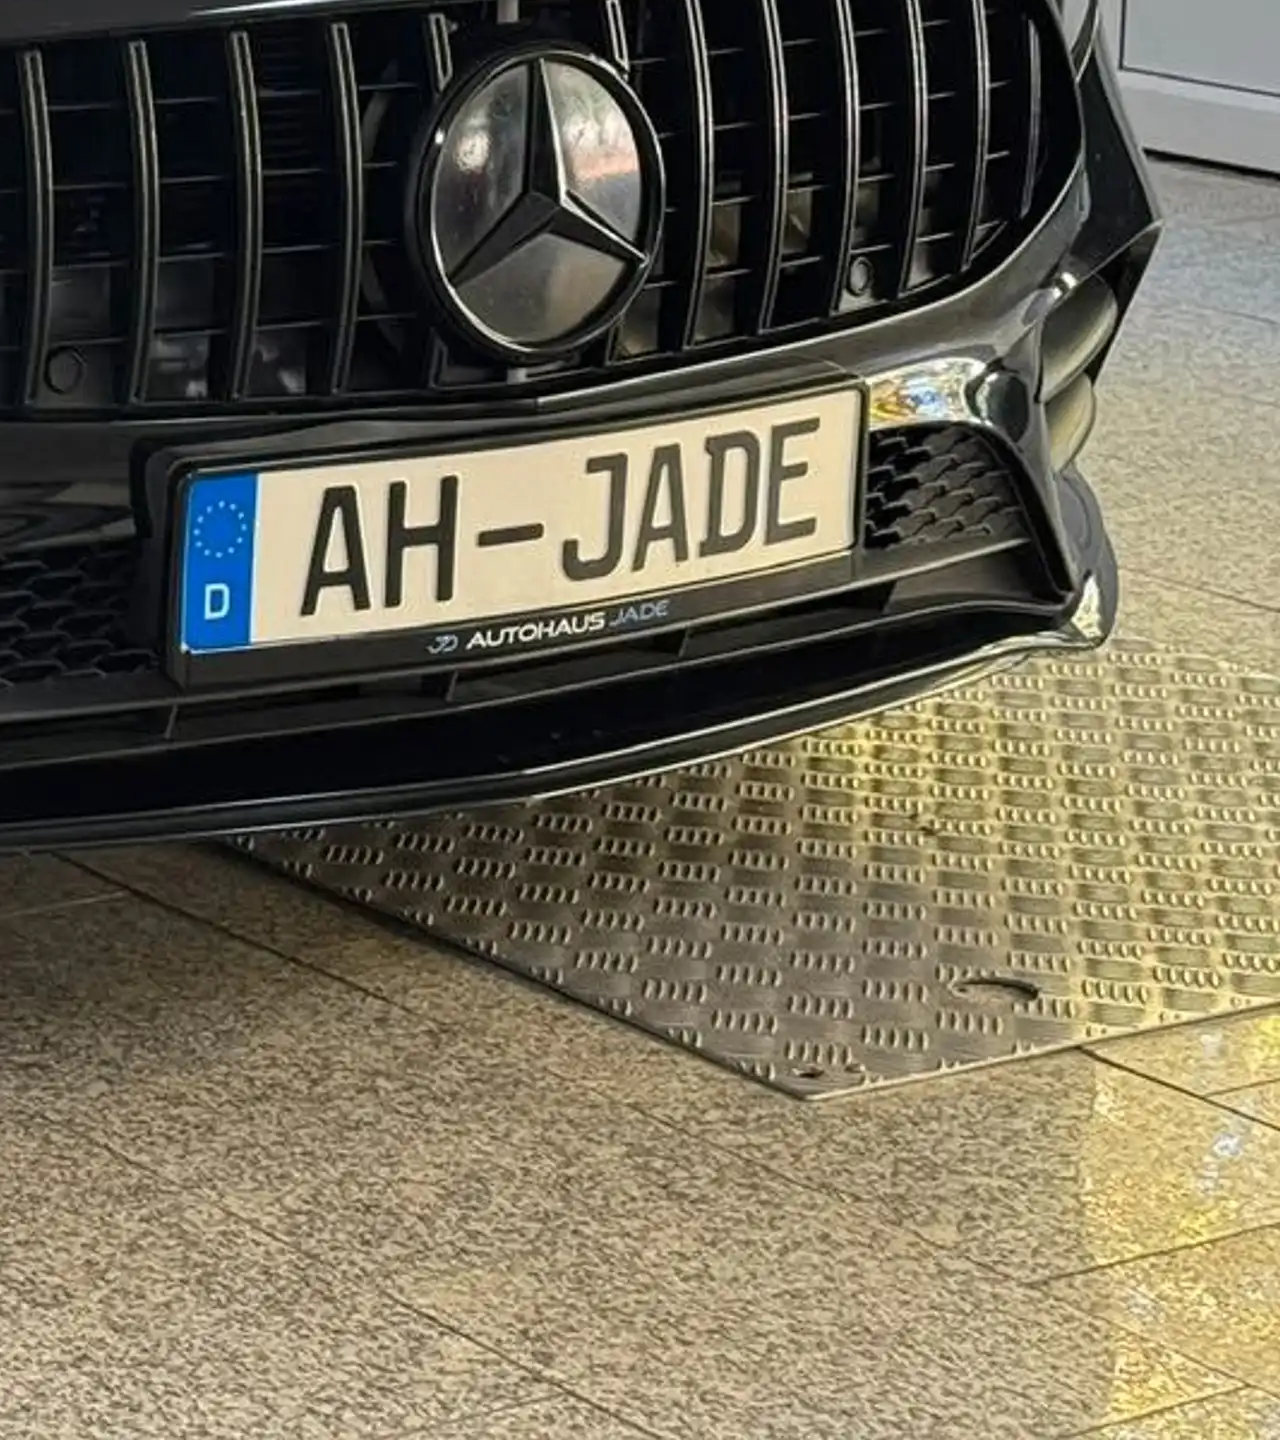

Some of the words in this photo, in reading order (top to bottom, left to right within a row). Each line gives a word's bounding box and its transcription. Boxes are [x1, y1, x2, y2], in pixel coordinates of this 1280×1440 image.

[204, 583, 230, 620] D
[466, 612, 605, 650] AUTOHAUS
[609, 599, 670, 627] JADE
